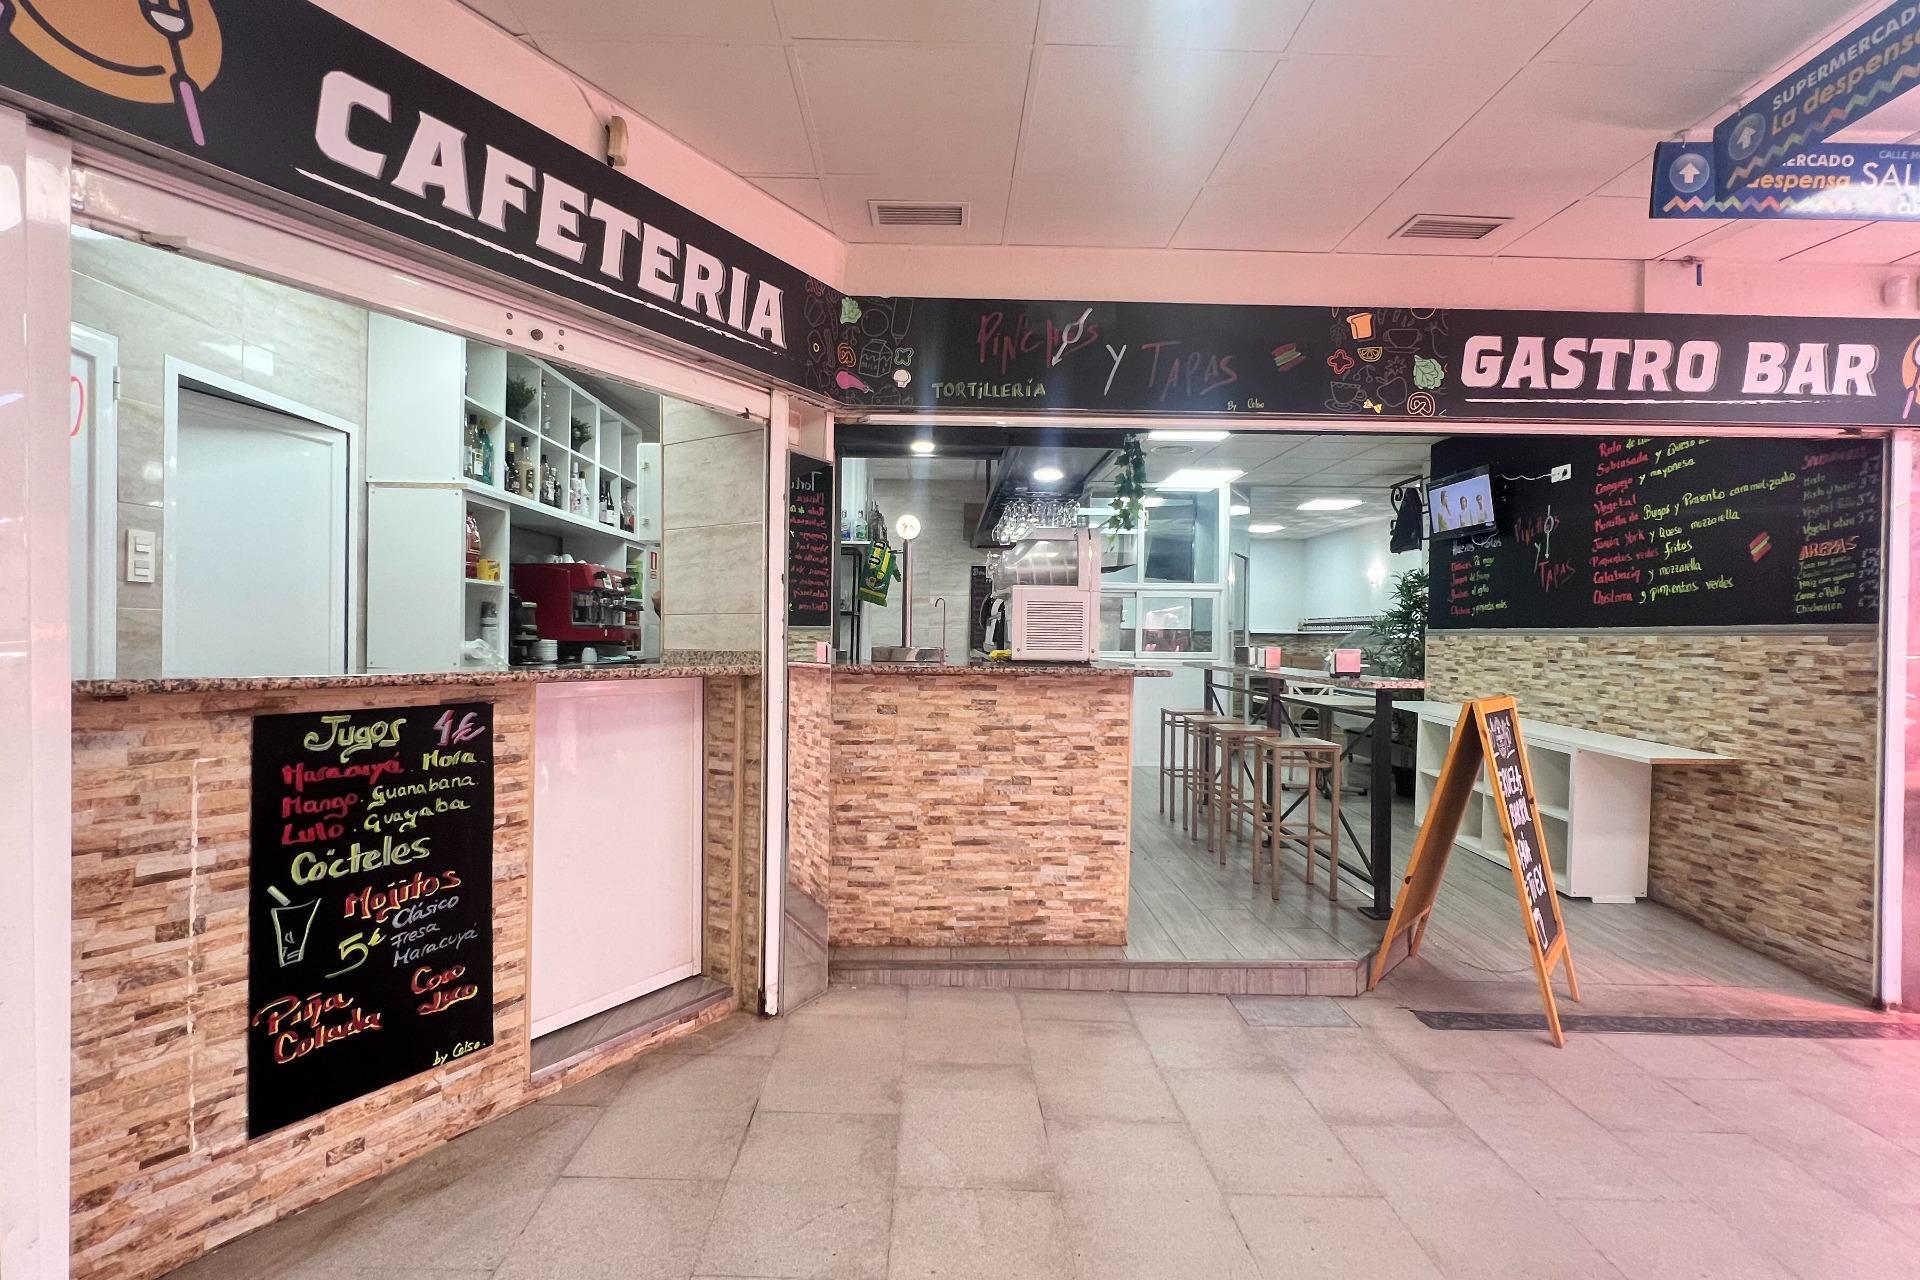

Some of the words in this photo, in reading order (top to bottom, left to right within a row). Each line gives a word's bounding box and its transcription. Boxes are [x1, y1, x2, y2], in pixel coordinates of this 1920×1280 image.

[1772, 0, 1920, 111] SUPERMERCAD
[1772, 109, 1796, 136] La
[1879, 150, 1907, 159] CALLE
[315, 69, 789, 350] CAFETERIA
[1460, 336, 1721, 393] GASTRO
[1741, 341, 1878, 397] BAR
[1650, 458, 1696, 478] mayonesa
[1643, 504, 1670, 521] Burgos
[1658, 526, 1683, 538] Queso
[1690, 509, 1741, 529] mozzarella
[1664, 540, 1693, 561] fritos
[1659, 561, 1703, 577] mozzarella
[1650, 582, 1700, 604] pimientos
[1705, 575, 1735, 591] verdes
[304, 715, 406, 763] Jugos
[281, 793, 359, 820] Mango
[281, 822, 344, 845] Lulo
[363, 798, 471, 833] Guayaba
[392, 896, 459, 928] Clásico
[390, 923, 440, 947] Fresa
[274, 1008, 383, 1065] Colada
[432, 1051, 448, 1066] by
